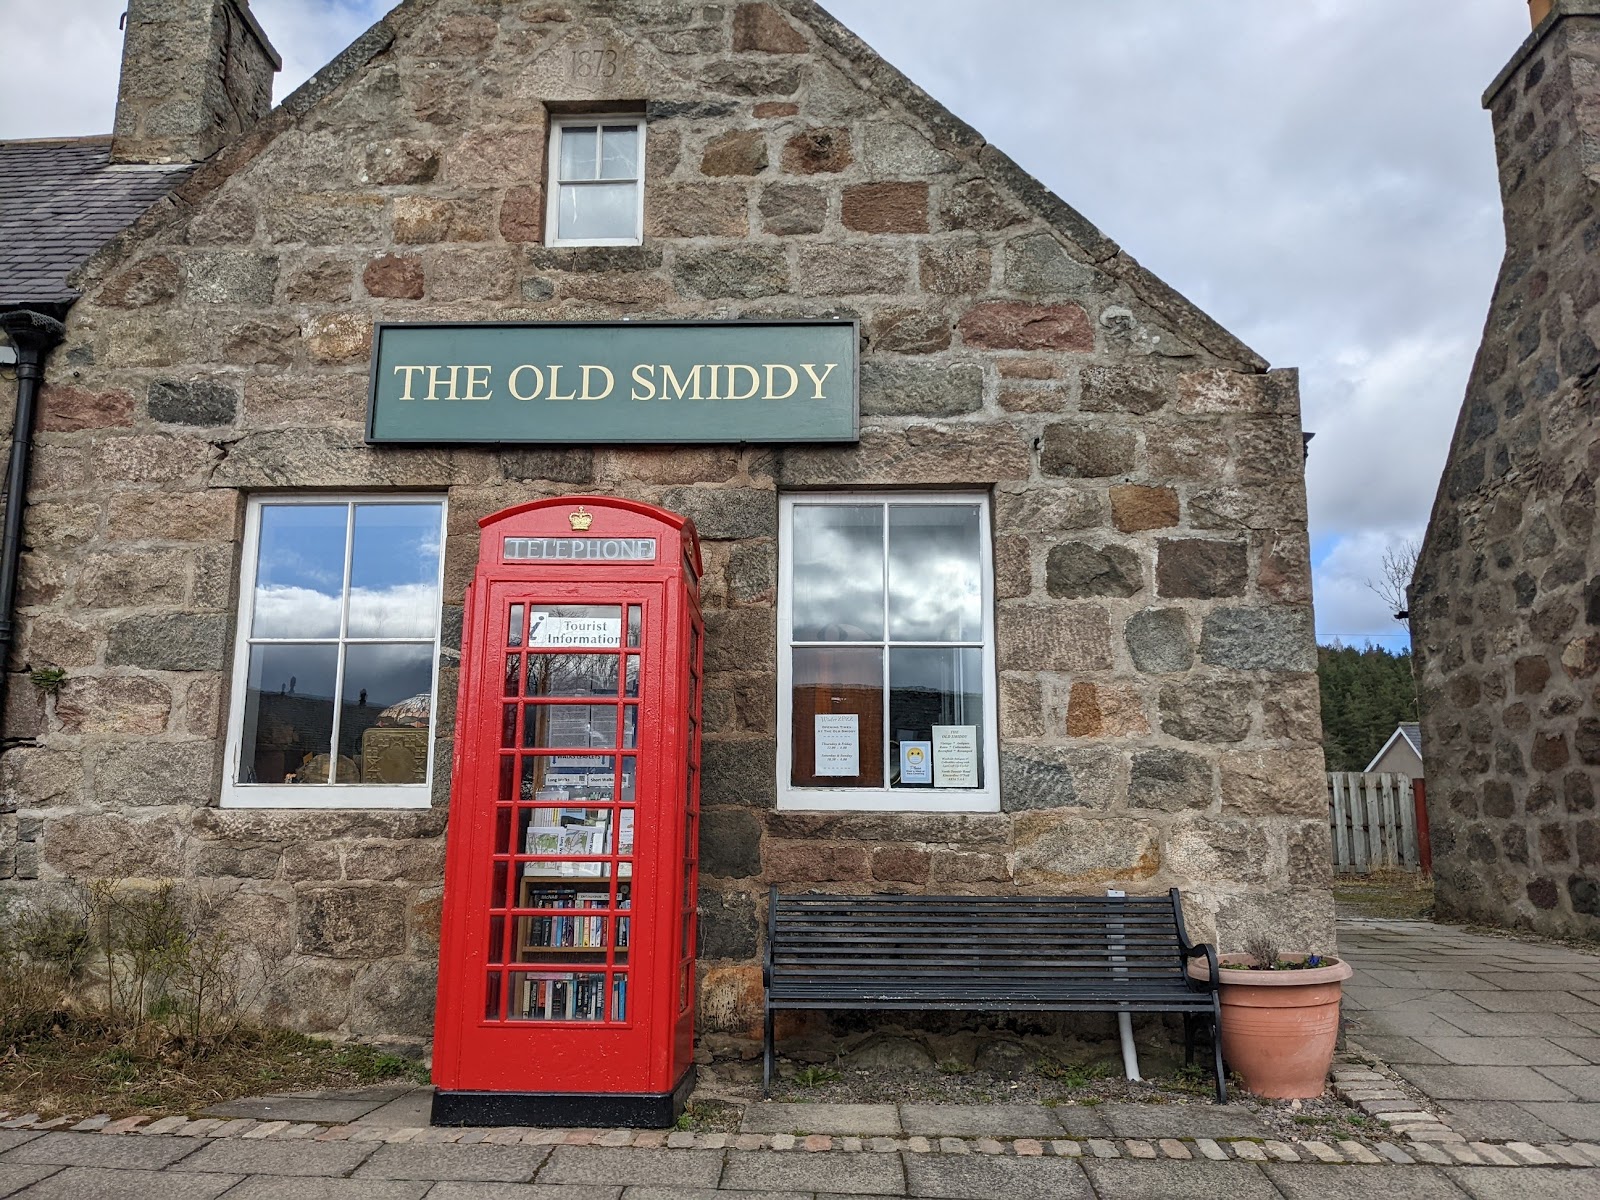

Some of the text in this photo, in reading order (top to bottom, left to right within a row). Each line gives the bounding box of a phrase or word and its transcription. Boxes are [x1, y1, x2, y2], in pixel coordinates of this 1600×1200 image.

[572, 49, 617, 78] 1873
[394, 363, 838, 401] THE OLD SMIDDY
[510, 540, 651, 558] TELEPHONE
[564, 620, 607, 631] Tourist
[548, 634, 621, 644] Information
